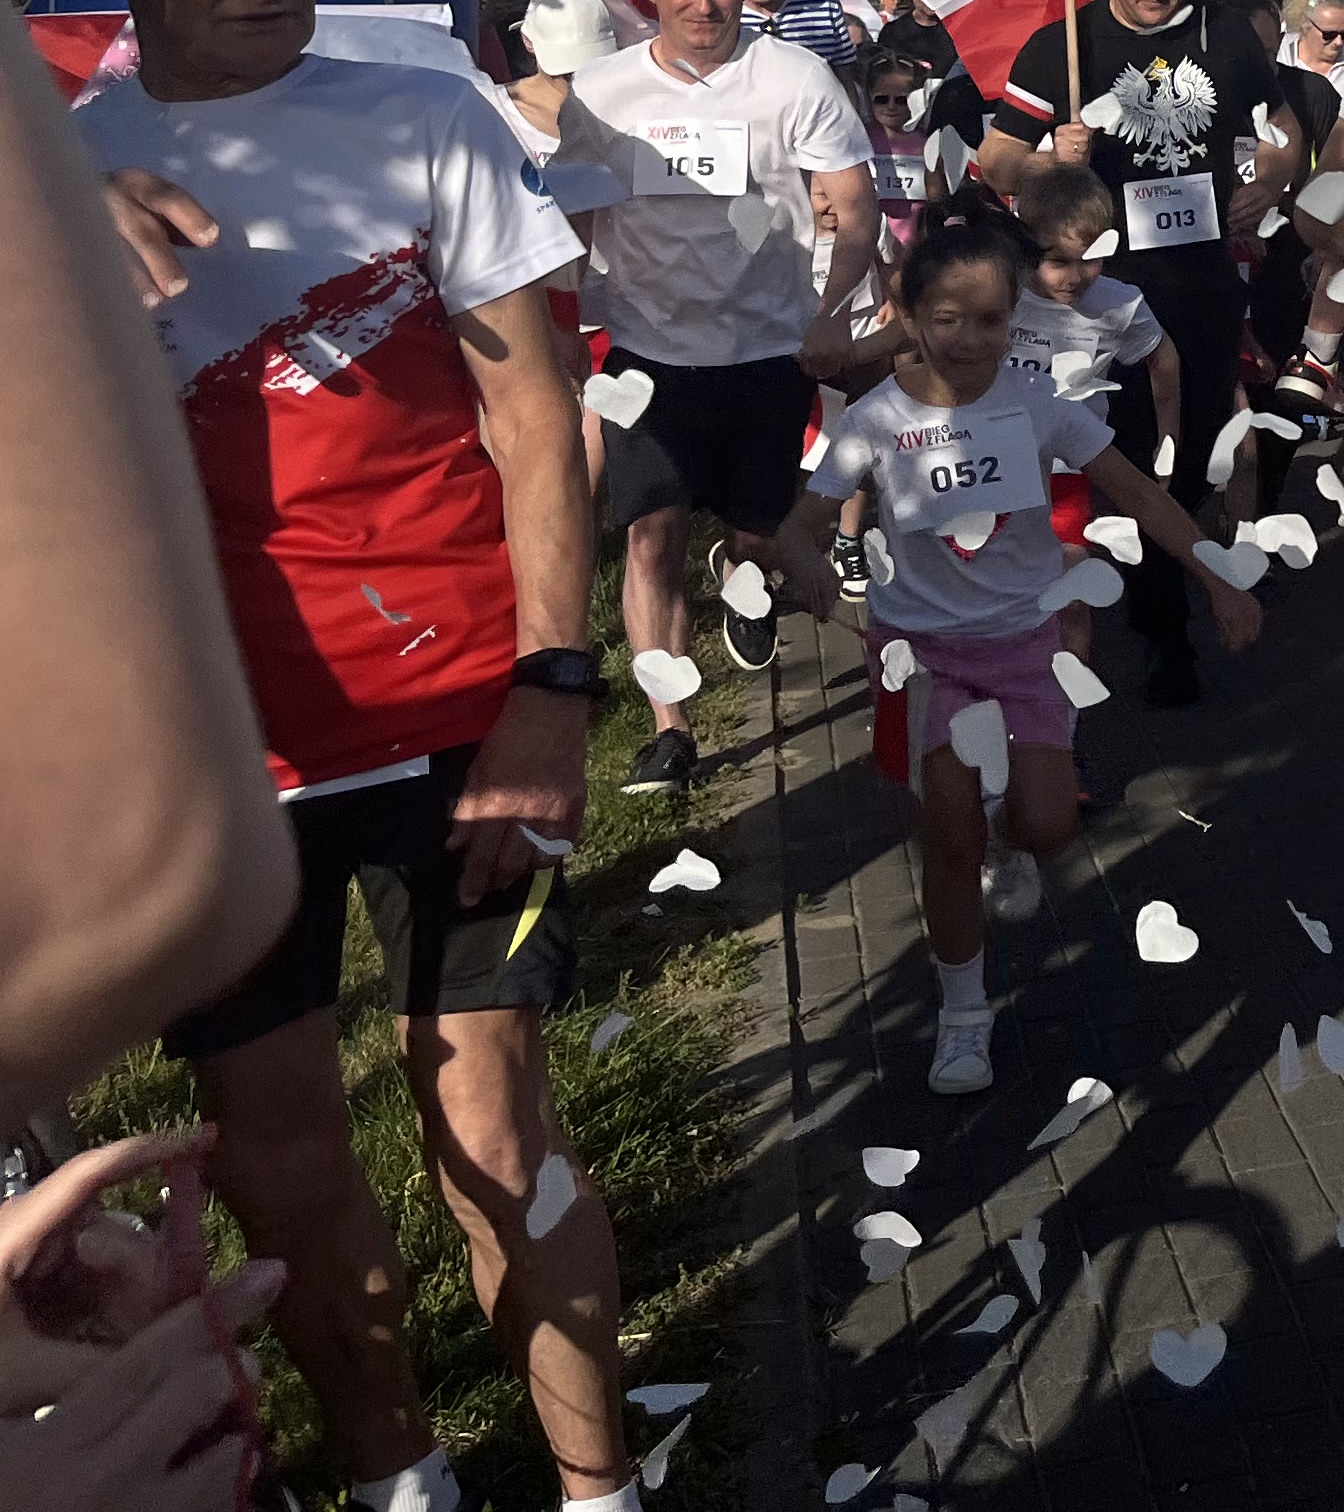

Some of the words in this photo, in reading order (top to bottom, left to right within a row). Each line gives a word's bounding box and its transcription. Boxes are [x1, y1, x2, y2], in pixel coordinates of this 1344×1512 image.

[664, 156, 715, 177] 105
[885, 176, 914, 189] 137
[1156, 209, 1196, 230] 013
[894, 428, 925, 452] XIV
[925, 424, 950, 437] BIEG
[930, 456, 1003, 493] 052
